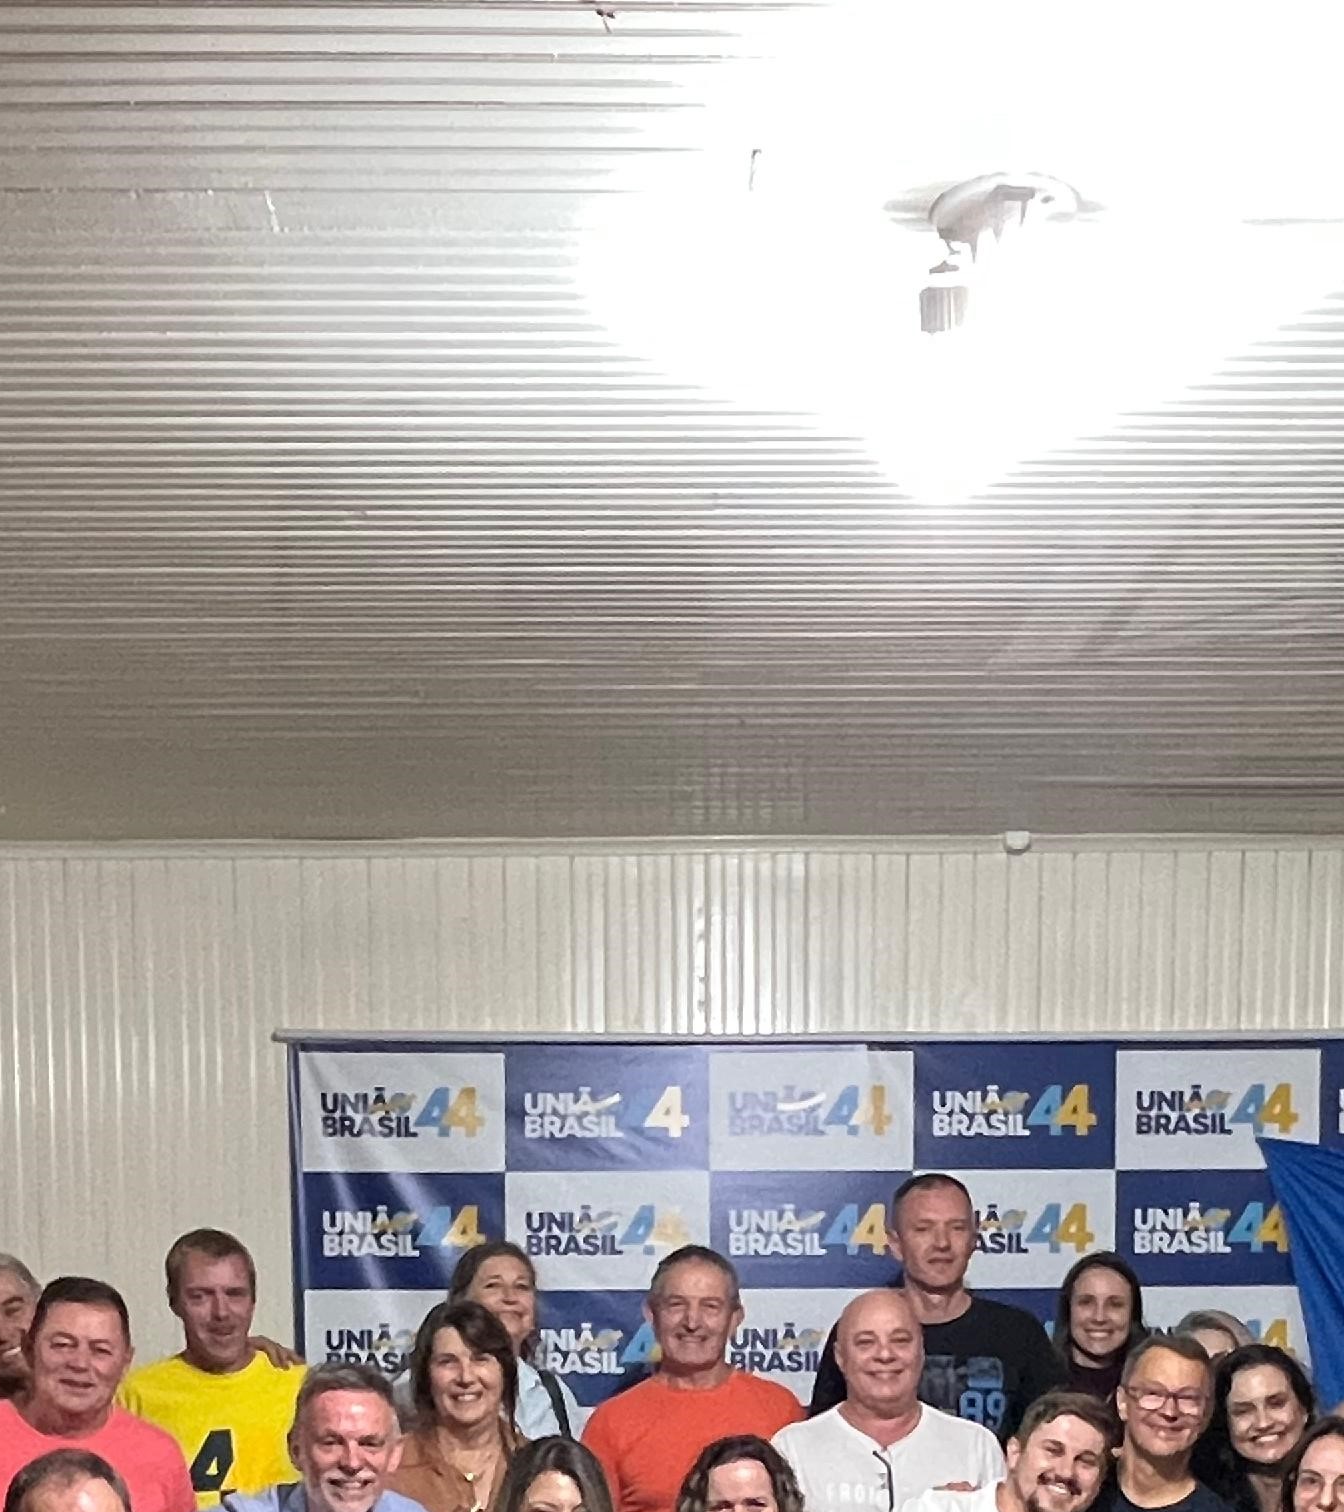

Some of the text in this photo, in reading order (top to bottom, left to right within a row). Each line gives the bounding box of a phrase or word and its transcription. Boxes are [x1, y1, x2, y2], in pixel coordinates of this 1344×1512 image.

[414, 1086, 486, 1138] 44
[1026, 1084, 1098, 1137] 44
[1229, 1083, 1299, 1137] 44
[321, 1115, 418, 1138] BRASIL
[524, 1115, 624, 1138] BRASIL
[932, 1114, 1031, 1137] BRASIL
[1136, 1113, 1233, 1136] BRASIL
[821, 1203, 889, 1256] 44
[1025, 1203, 1095, 1254] 44
[1227, 1201, 1289, 1254] 44
[322, 1234, 420, 1257] BRASIL
[526, 1234, 624, 1256] BRASIL
[728, 1232, 827, 1256] BRASIL
[971, 1232, 1029, 1254] ASIL
[1134, 1231, 1232, 1254] BRASIL
[540, 1322, 623, 1351] NIÃO
